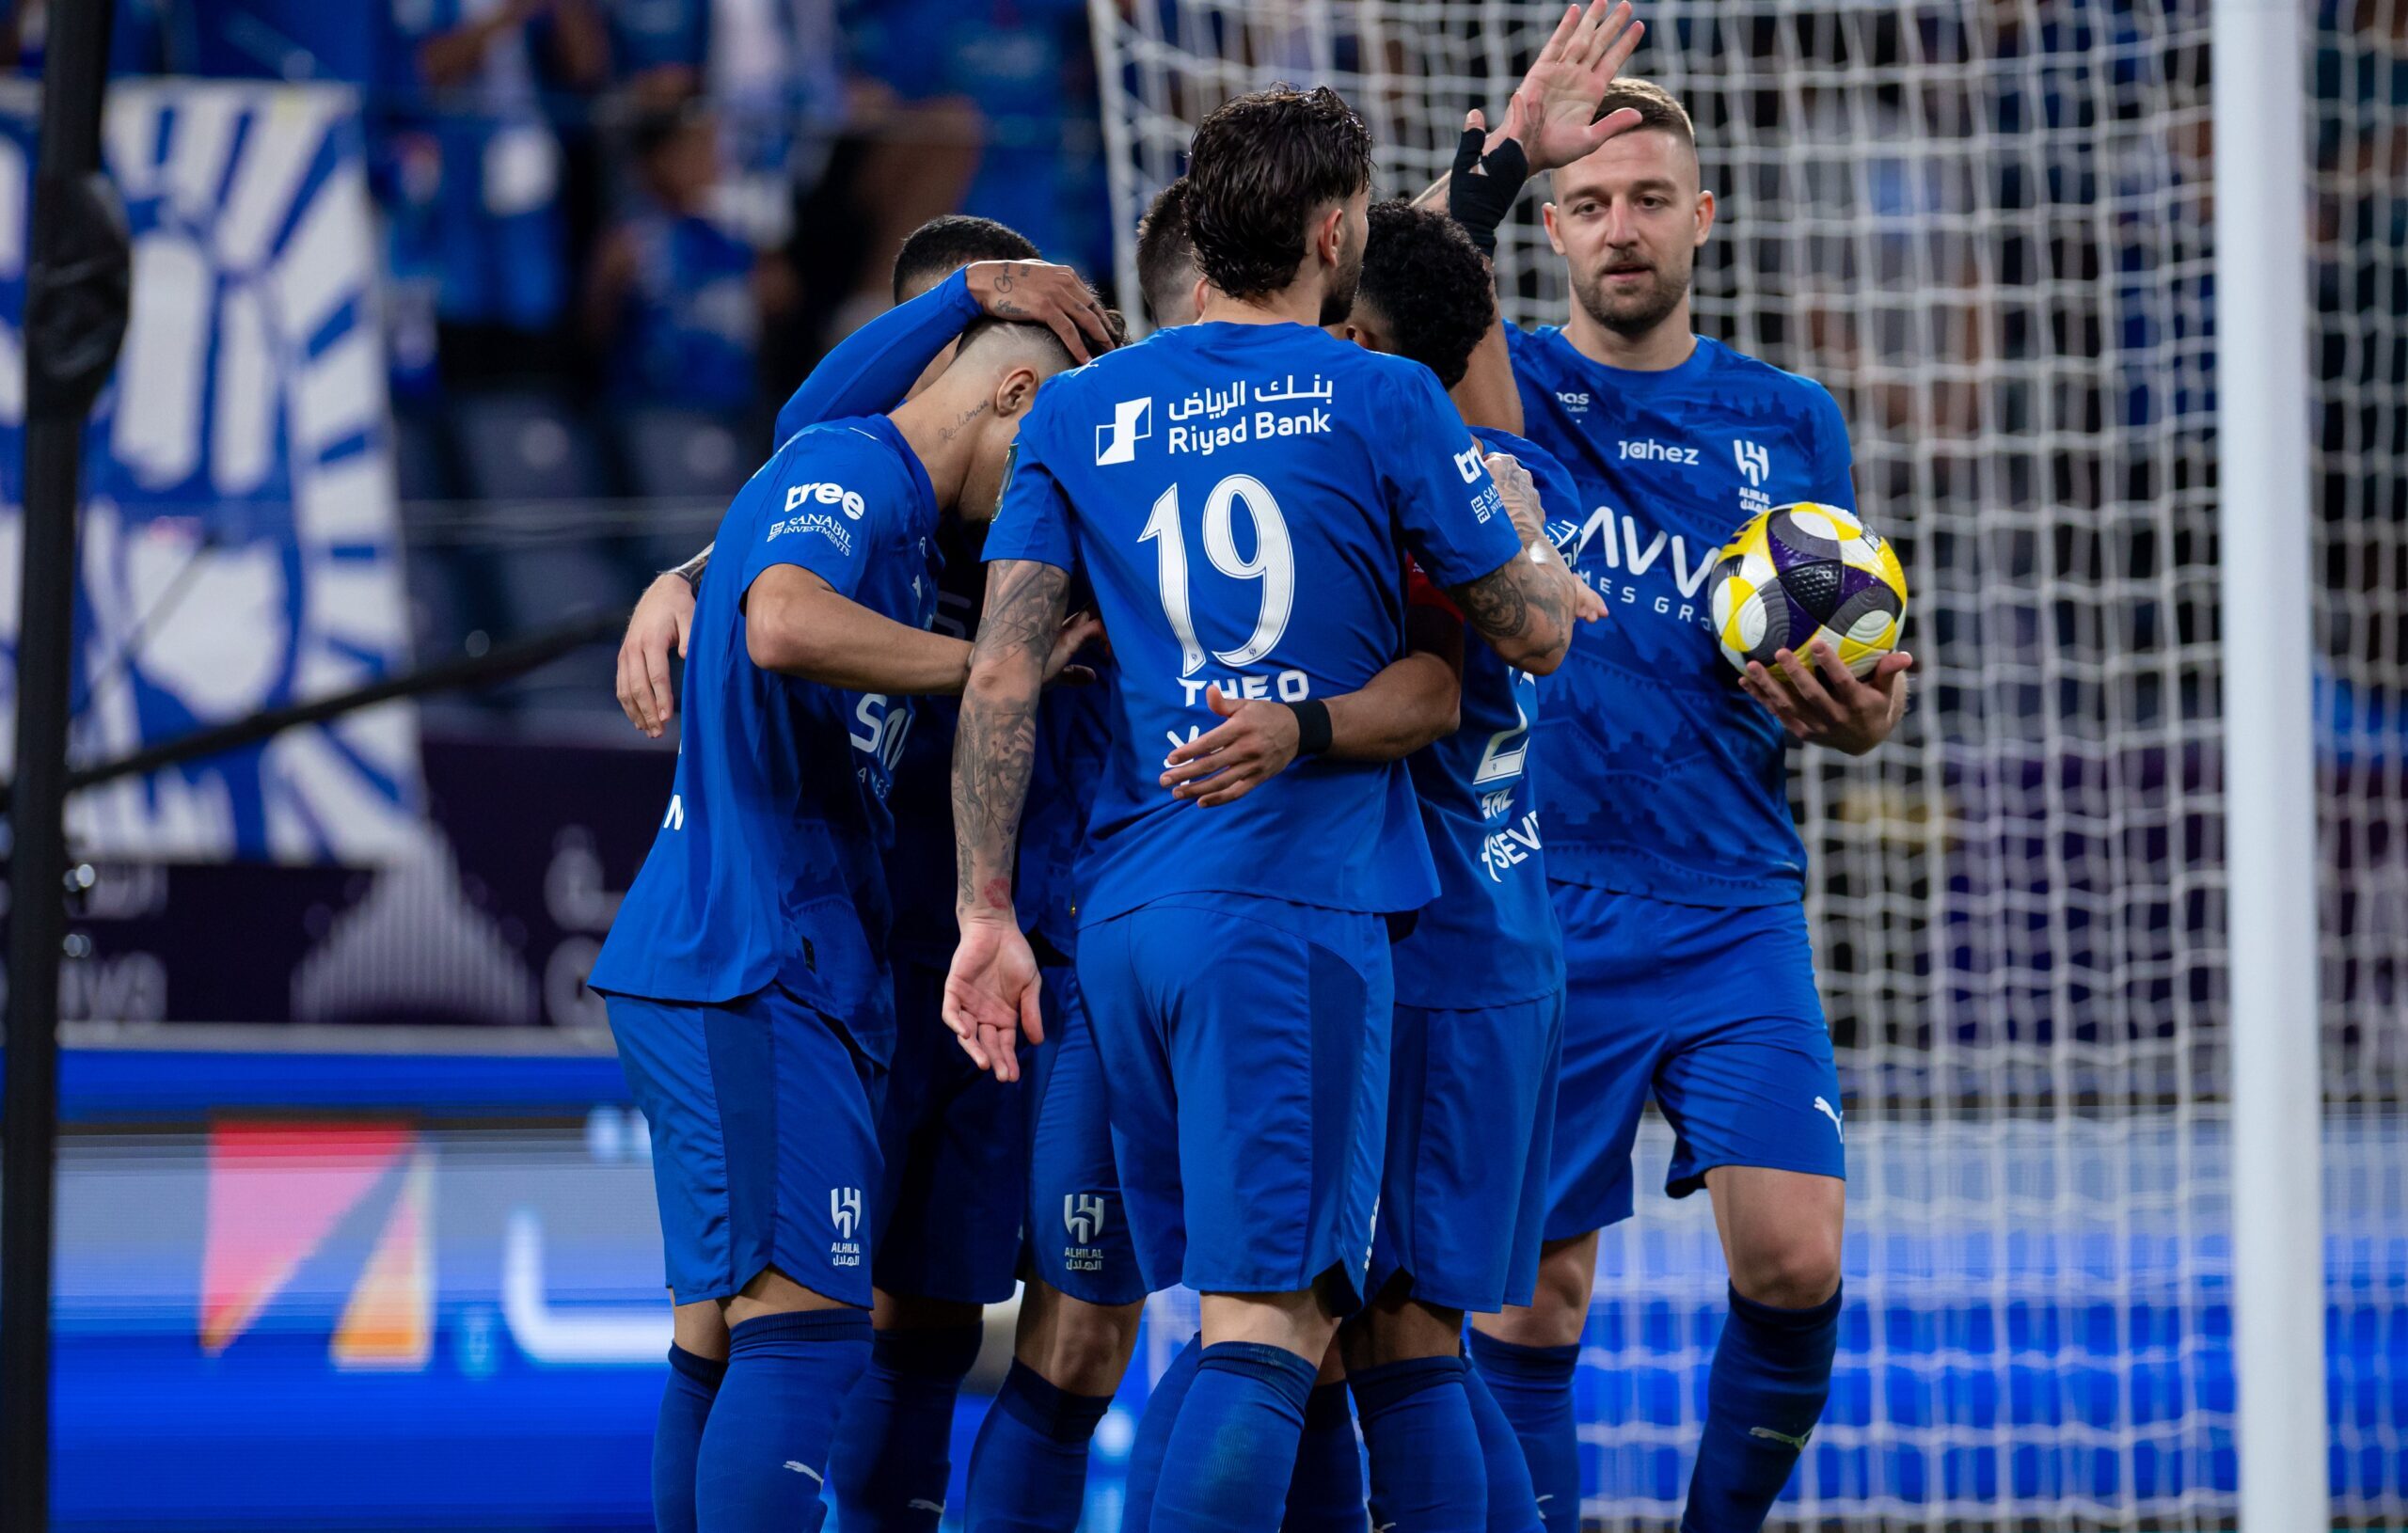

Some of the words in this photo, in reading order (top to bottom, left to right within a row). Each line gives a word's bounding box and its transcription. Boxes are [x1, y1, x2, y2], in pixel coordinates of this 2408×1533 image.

[1168, 380, 1246, 421] الرياض
[1254, 373, 1333, 404] بنك
[1168, 416, 1247, 456] Riyad
[1255, 407, 1332, 440] Bank
[1453, 445, 1487, 484] tr
[784, 482, 864, 520] tree
[783, 525, 850, 557] INVESTMENTS
[789, 514, 851, 547] SANABIL
[1136, 473, 1295, 677] 19
[1176, 669, 1310, 707] THEO
[1481, 786, 1514, 820] SAL
[831, 1241, 860, 1254] ALHILAL
[1064, 1246, 1103, 1258] ALHILAL
